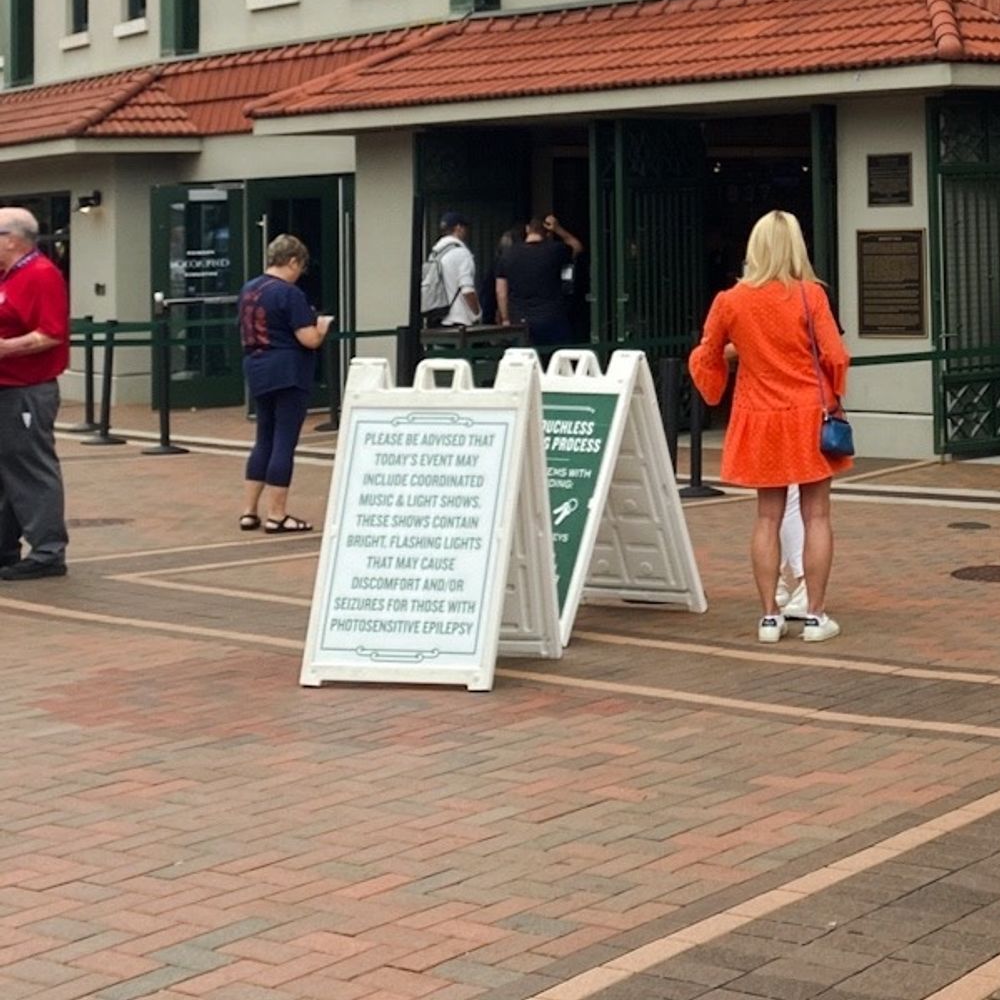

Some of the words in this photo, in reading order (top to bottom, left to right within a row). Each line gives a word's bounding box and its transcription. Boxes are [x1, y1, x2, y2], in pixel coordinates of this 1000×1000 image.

[364, 432, 403, 446] PLEASE
[406, 433, 419, 446] BE
[420, 433, 466, 446] ADVISED
[469, 433, 495, 447] THAT
[552, 436, 601, 452] PROCESS
[375, 453, 418, 466] TODAY'S
[420, 453, 454, 466] EVENT
[456, 454, 479, 467] MAY
[363, 473, 409, 487] INCLUDE
[410, 474, 484, 488] COORDINATED
[568, 467, 592, 479] WITH
[358, 493, 394, 506] MUSIC
[407, 494, 440, 508] LIGHT
[357, 514, 390, 527] THESE
[391, 514, 430, 528] SHOWS
[432, 515, 479, 529] CONTAIN
[389, 535, 441, 549] FLASHING
[443, 536, 482, 550] LIGHTS
[366, 556, 394, 569] THAT
[395, 556, 419, 570] MAY
[421, 557, 456, 571] CAUSE
[351, 576, 421, 591] DISCOMFORT
[422, 578, 465, 592] AND/OR
[334, 597, 385, 612] SEIZURES
[386, 599, 408, 612] FOR
[411, 600, 445, 613] THOSE
[447, 600, 476, 614] WITH
[330, 618, 421, 634] PHOTOSENSITIVE
[423, 620, 475, 636] EPILEPSY
